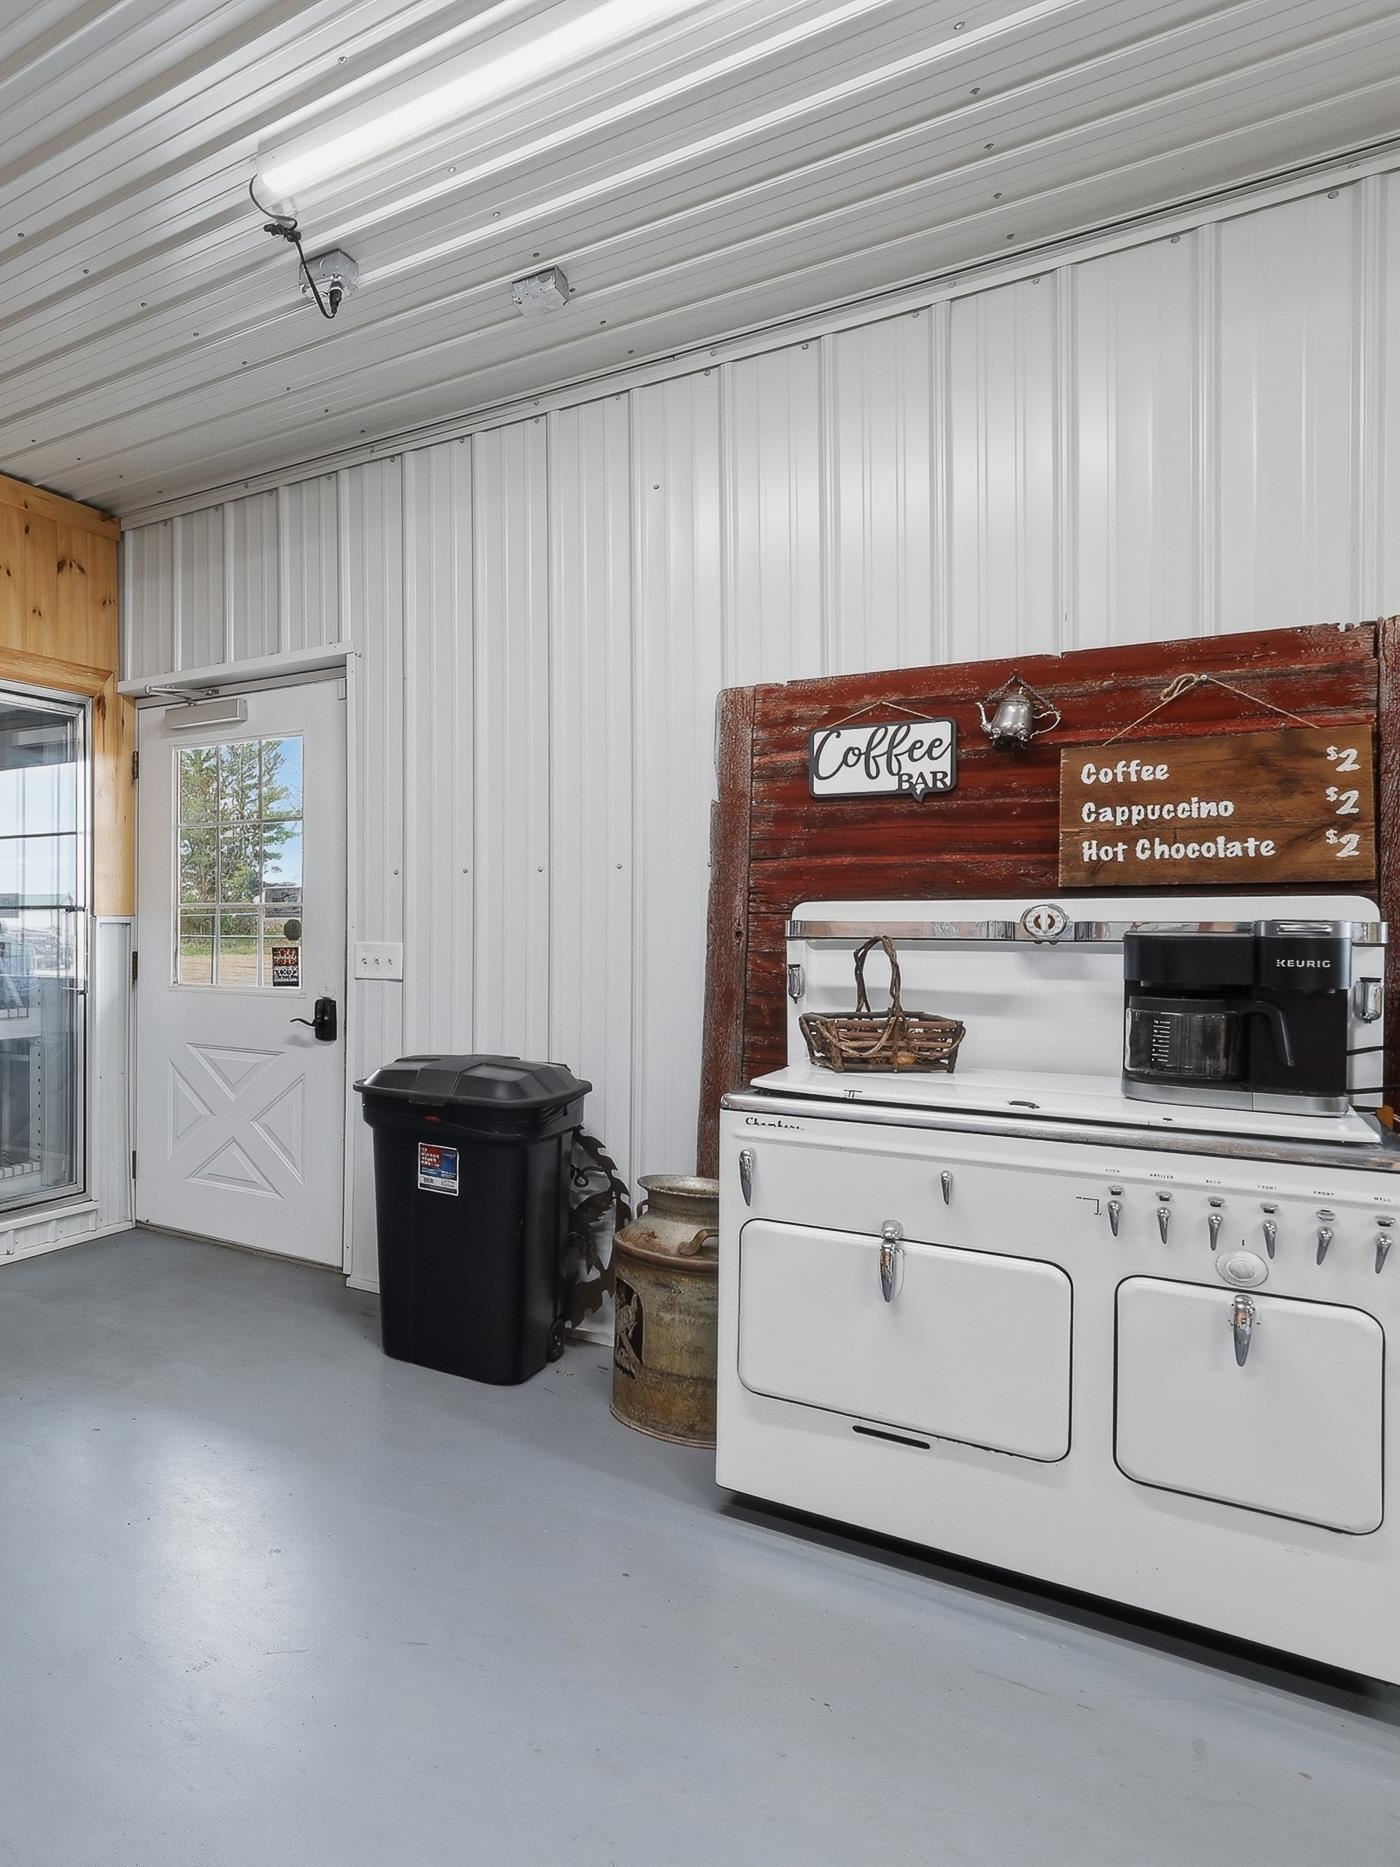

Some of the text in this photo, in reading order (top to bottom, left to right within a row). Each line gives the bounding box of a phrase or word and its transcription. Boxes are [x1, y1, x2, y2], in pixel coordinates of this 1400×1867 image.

[814, 724, 951, 780] Coffee
[1080, 745, 1361, 785] Coffee $2
[898, 771, 949, 790] BAR
[1081, 786, 1360, 826] Cappuccino $2
[1081, 828, 1361, 862] Hot Chocolate $2
[1276, 959, 1331, 968] KEURIG
